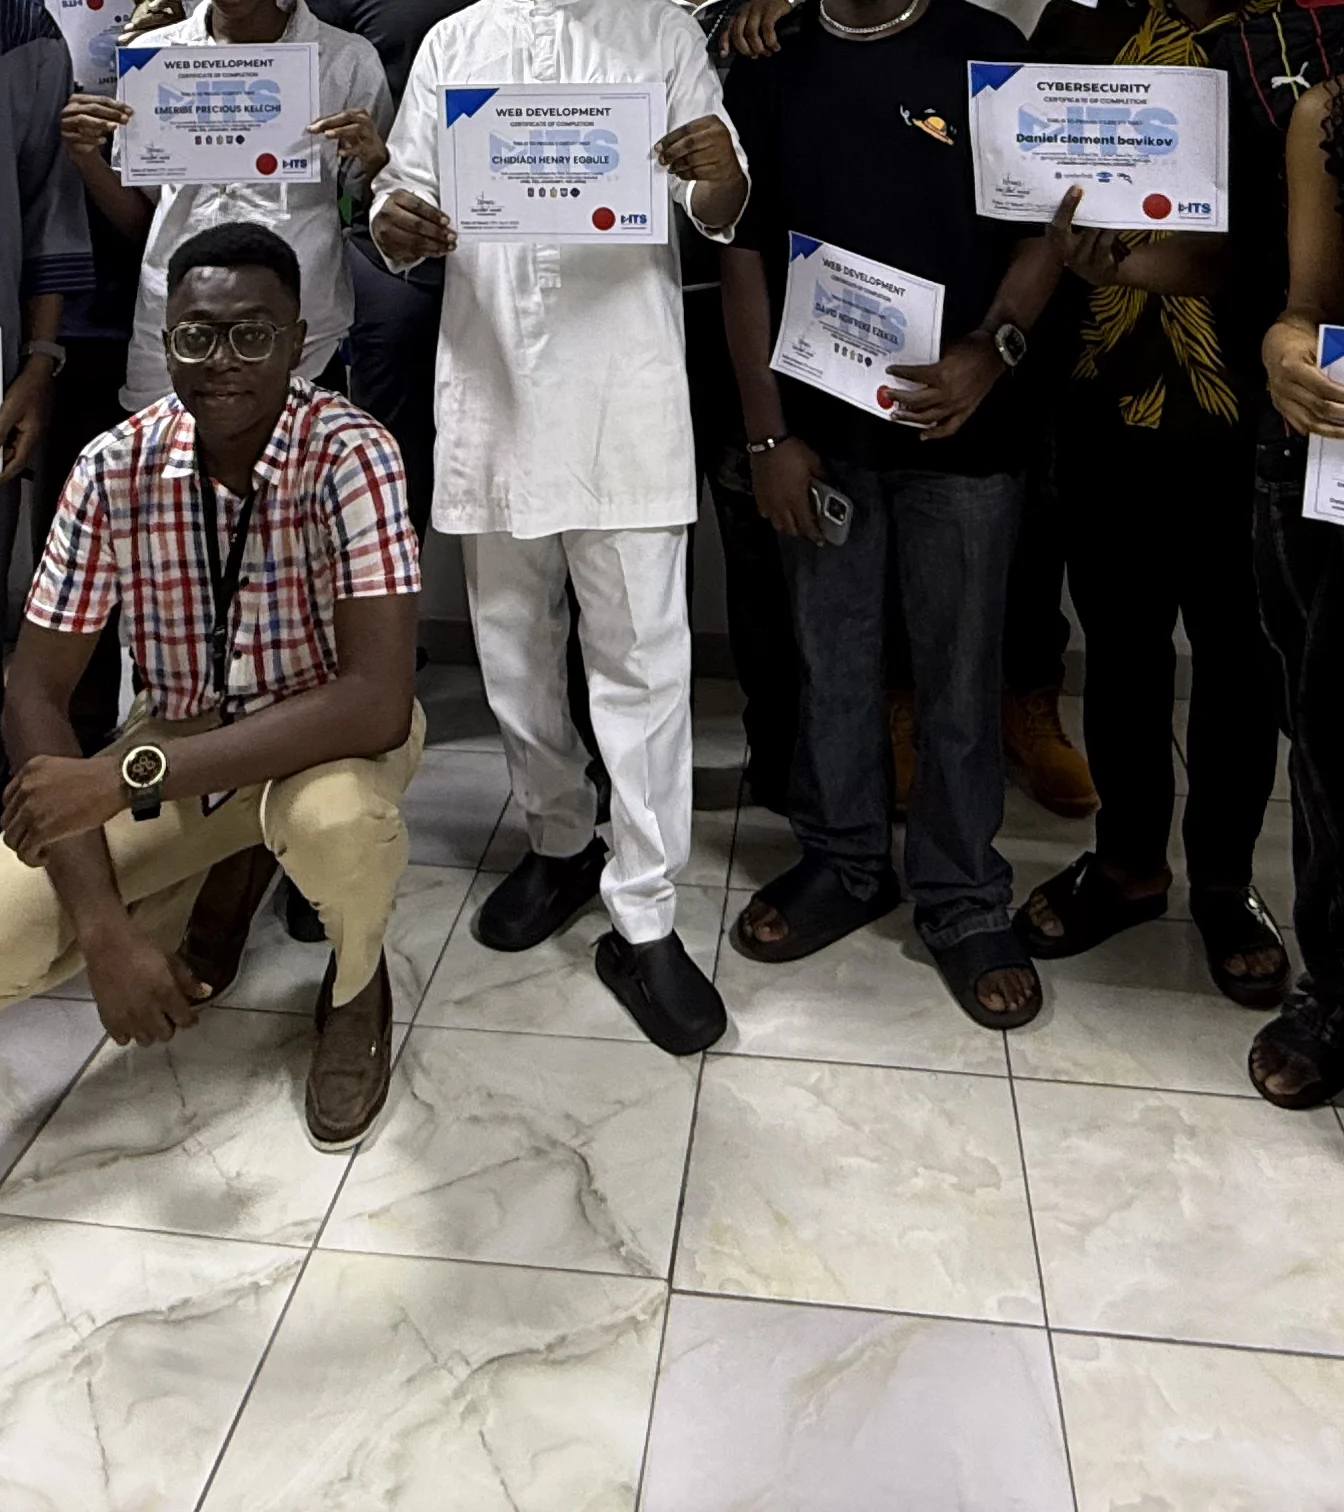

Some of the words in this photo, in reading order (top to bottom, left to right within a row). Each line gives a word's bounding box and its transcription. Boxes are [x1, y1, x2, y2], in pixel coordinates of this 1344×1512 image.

[164, 60, 191, 69] WEB
[193, 59, 274, 68] DEVELOPMENT
[1037, 81, 1151, 93] CYBERSECURITY
[196, 104, 241, 114] PRECIOUS
[244, 104, 281, 112] KELECHI
[496, 108, 523, 117] WEB
[526, 108, 611, 117] DEVELOPMENT
[1016, 133, 1057, 143] Daniel
[1060, 134, 1115, 145] clement
[1117, 135, 1173, 146] bavikov
[539, 155, 570, 164] HENRY
[822, 258, 842, 272] WEB
[844, 266, 906, 296] DEVELOPMENT
